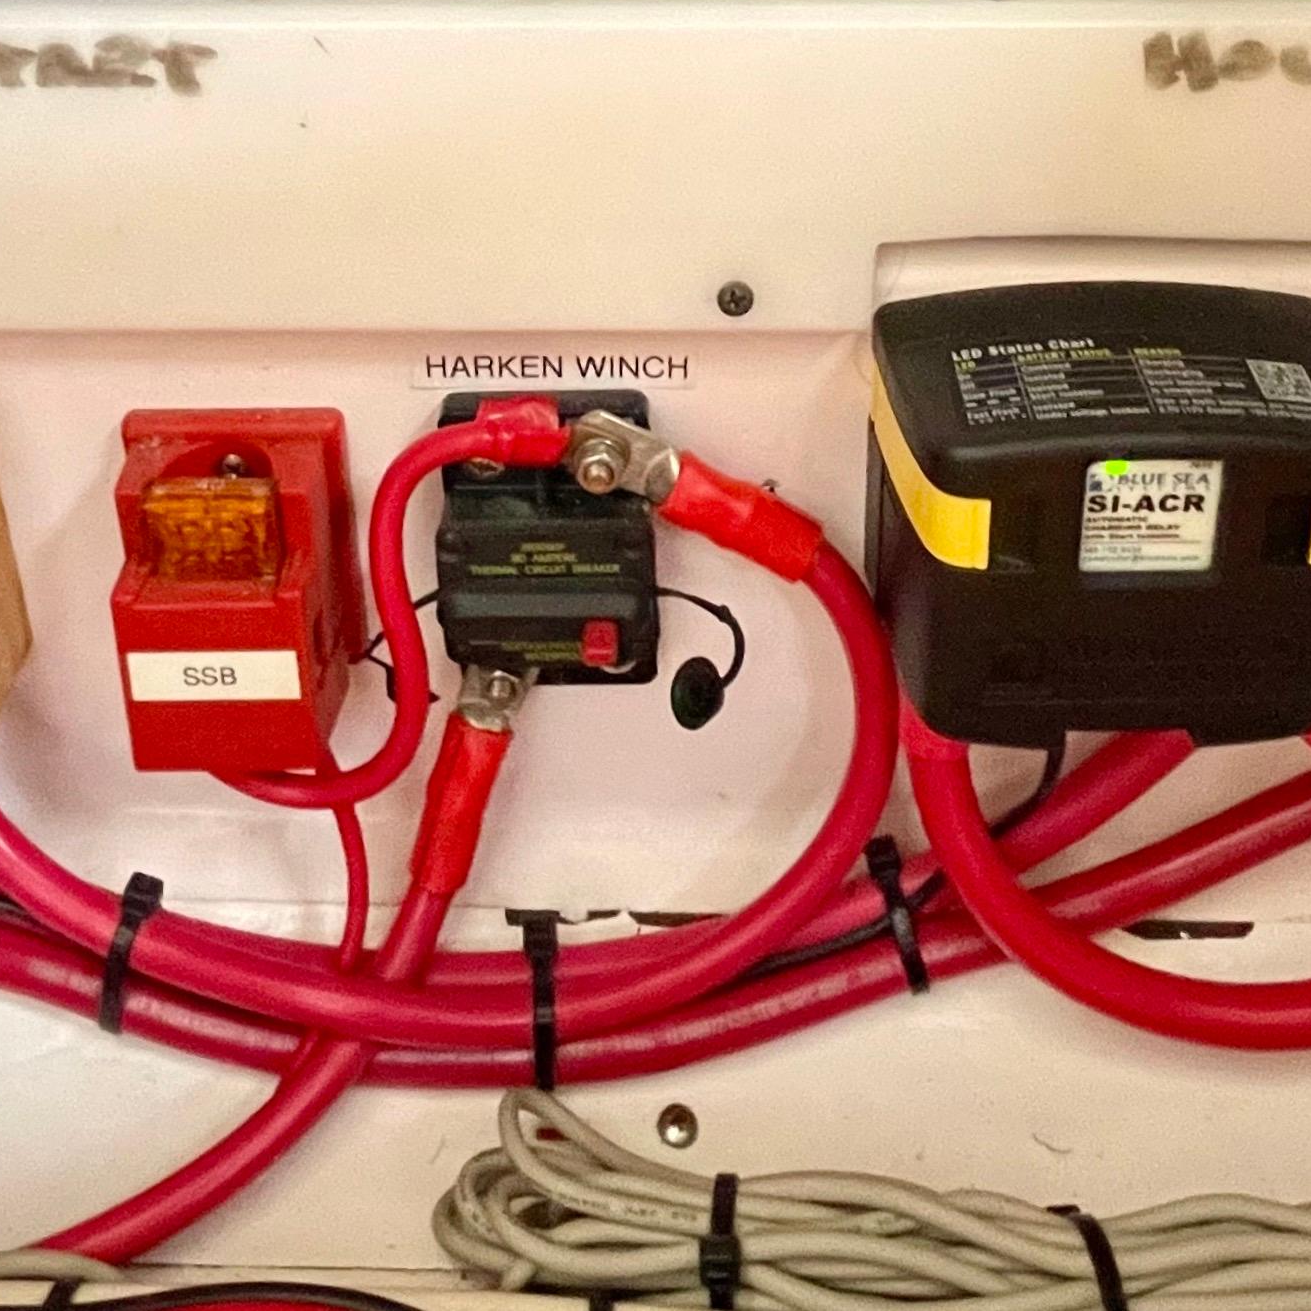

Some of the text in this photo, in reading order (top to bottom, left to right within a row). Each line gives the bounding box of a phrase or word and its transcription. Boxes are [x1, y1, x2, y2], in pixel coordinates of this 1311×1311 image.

[425, 354, 689, 380] HARKEN WINCH
[1172, 473, 1211, 486] SEA
[1087, 494, 1206, 514] SI-ACR
[182, 666, 238, 687] SSB
